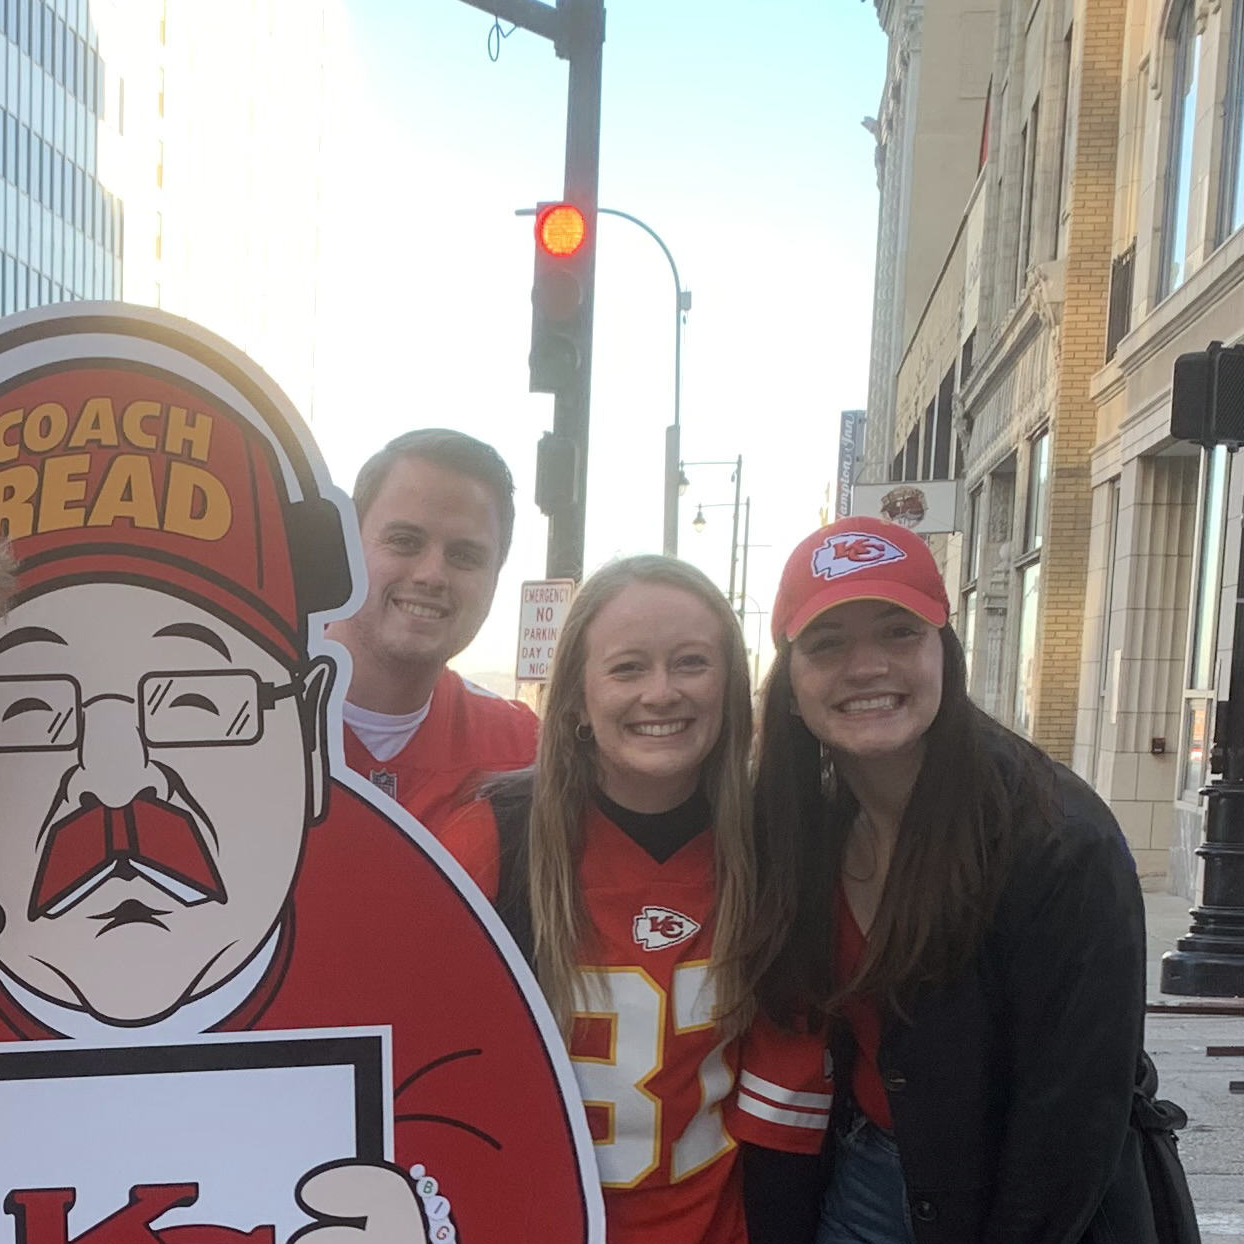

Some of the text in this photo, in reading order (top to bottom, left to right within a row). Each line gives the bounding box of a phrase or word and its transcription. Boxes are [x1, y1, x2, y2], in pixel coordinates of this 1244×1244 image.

[839, 413, 855, 518] ampton Inn
[833, 537, 886, 562] KC
[524, 588, 570, 603] EMERGENCY
[536, 607, 554, 622] NO
[524, 627, 557, 641] PARKIN
[522, 647, 542, 659] DAY
[529, 662, 549, 675] NIG
[648, 915, 684, 938] KC
[423, 1180, 450, 1240] BIG
